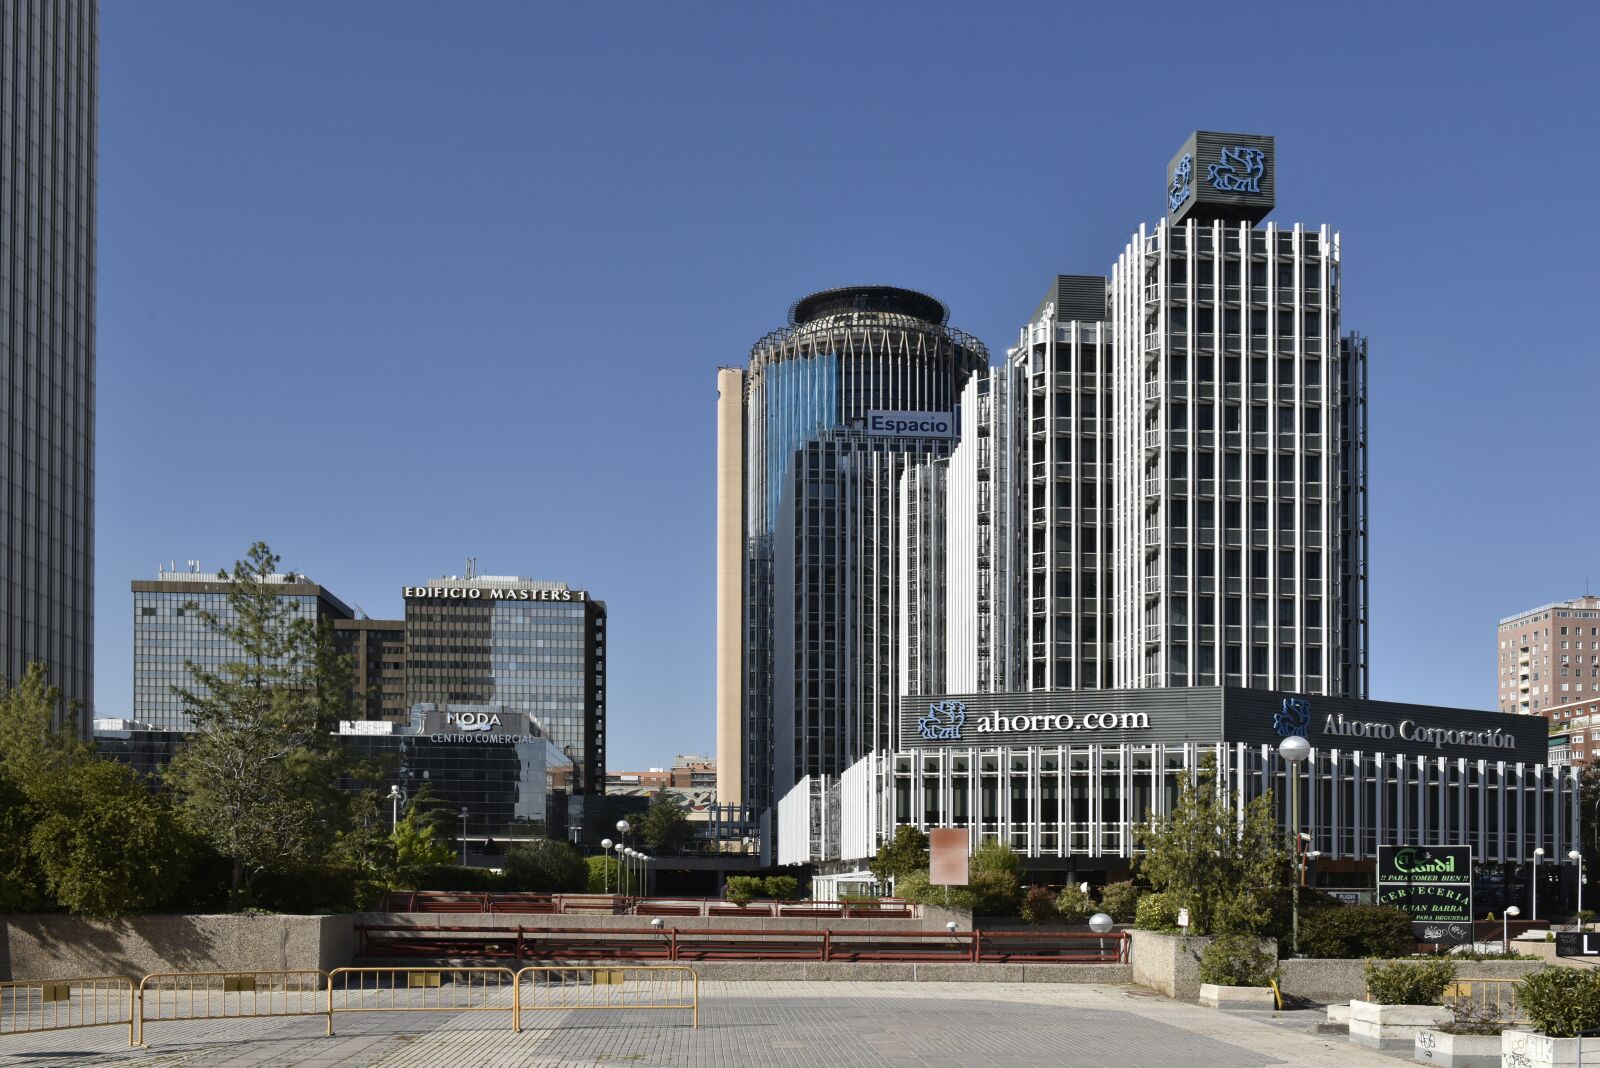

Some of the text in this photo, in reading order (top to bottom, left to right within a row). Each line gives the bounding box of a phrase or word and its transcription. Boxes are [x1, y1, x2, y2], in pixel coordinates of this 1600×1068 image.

[872, 416, 948, 434] Espacio
[405, 587, 480, 598] EDIFICIO
[577, 591, 585, 601] 1
[447, 712, 502, 726] MODA
[977, 710, 1151, 733] ahorro.com
[430, 733, 535, 744] CENTRO COMERCIAL
[1323, 713, 1516, 749] Ahorro Corporación
[1380, 886, 1469, 905] CERVECERIA
